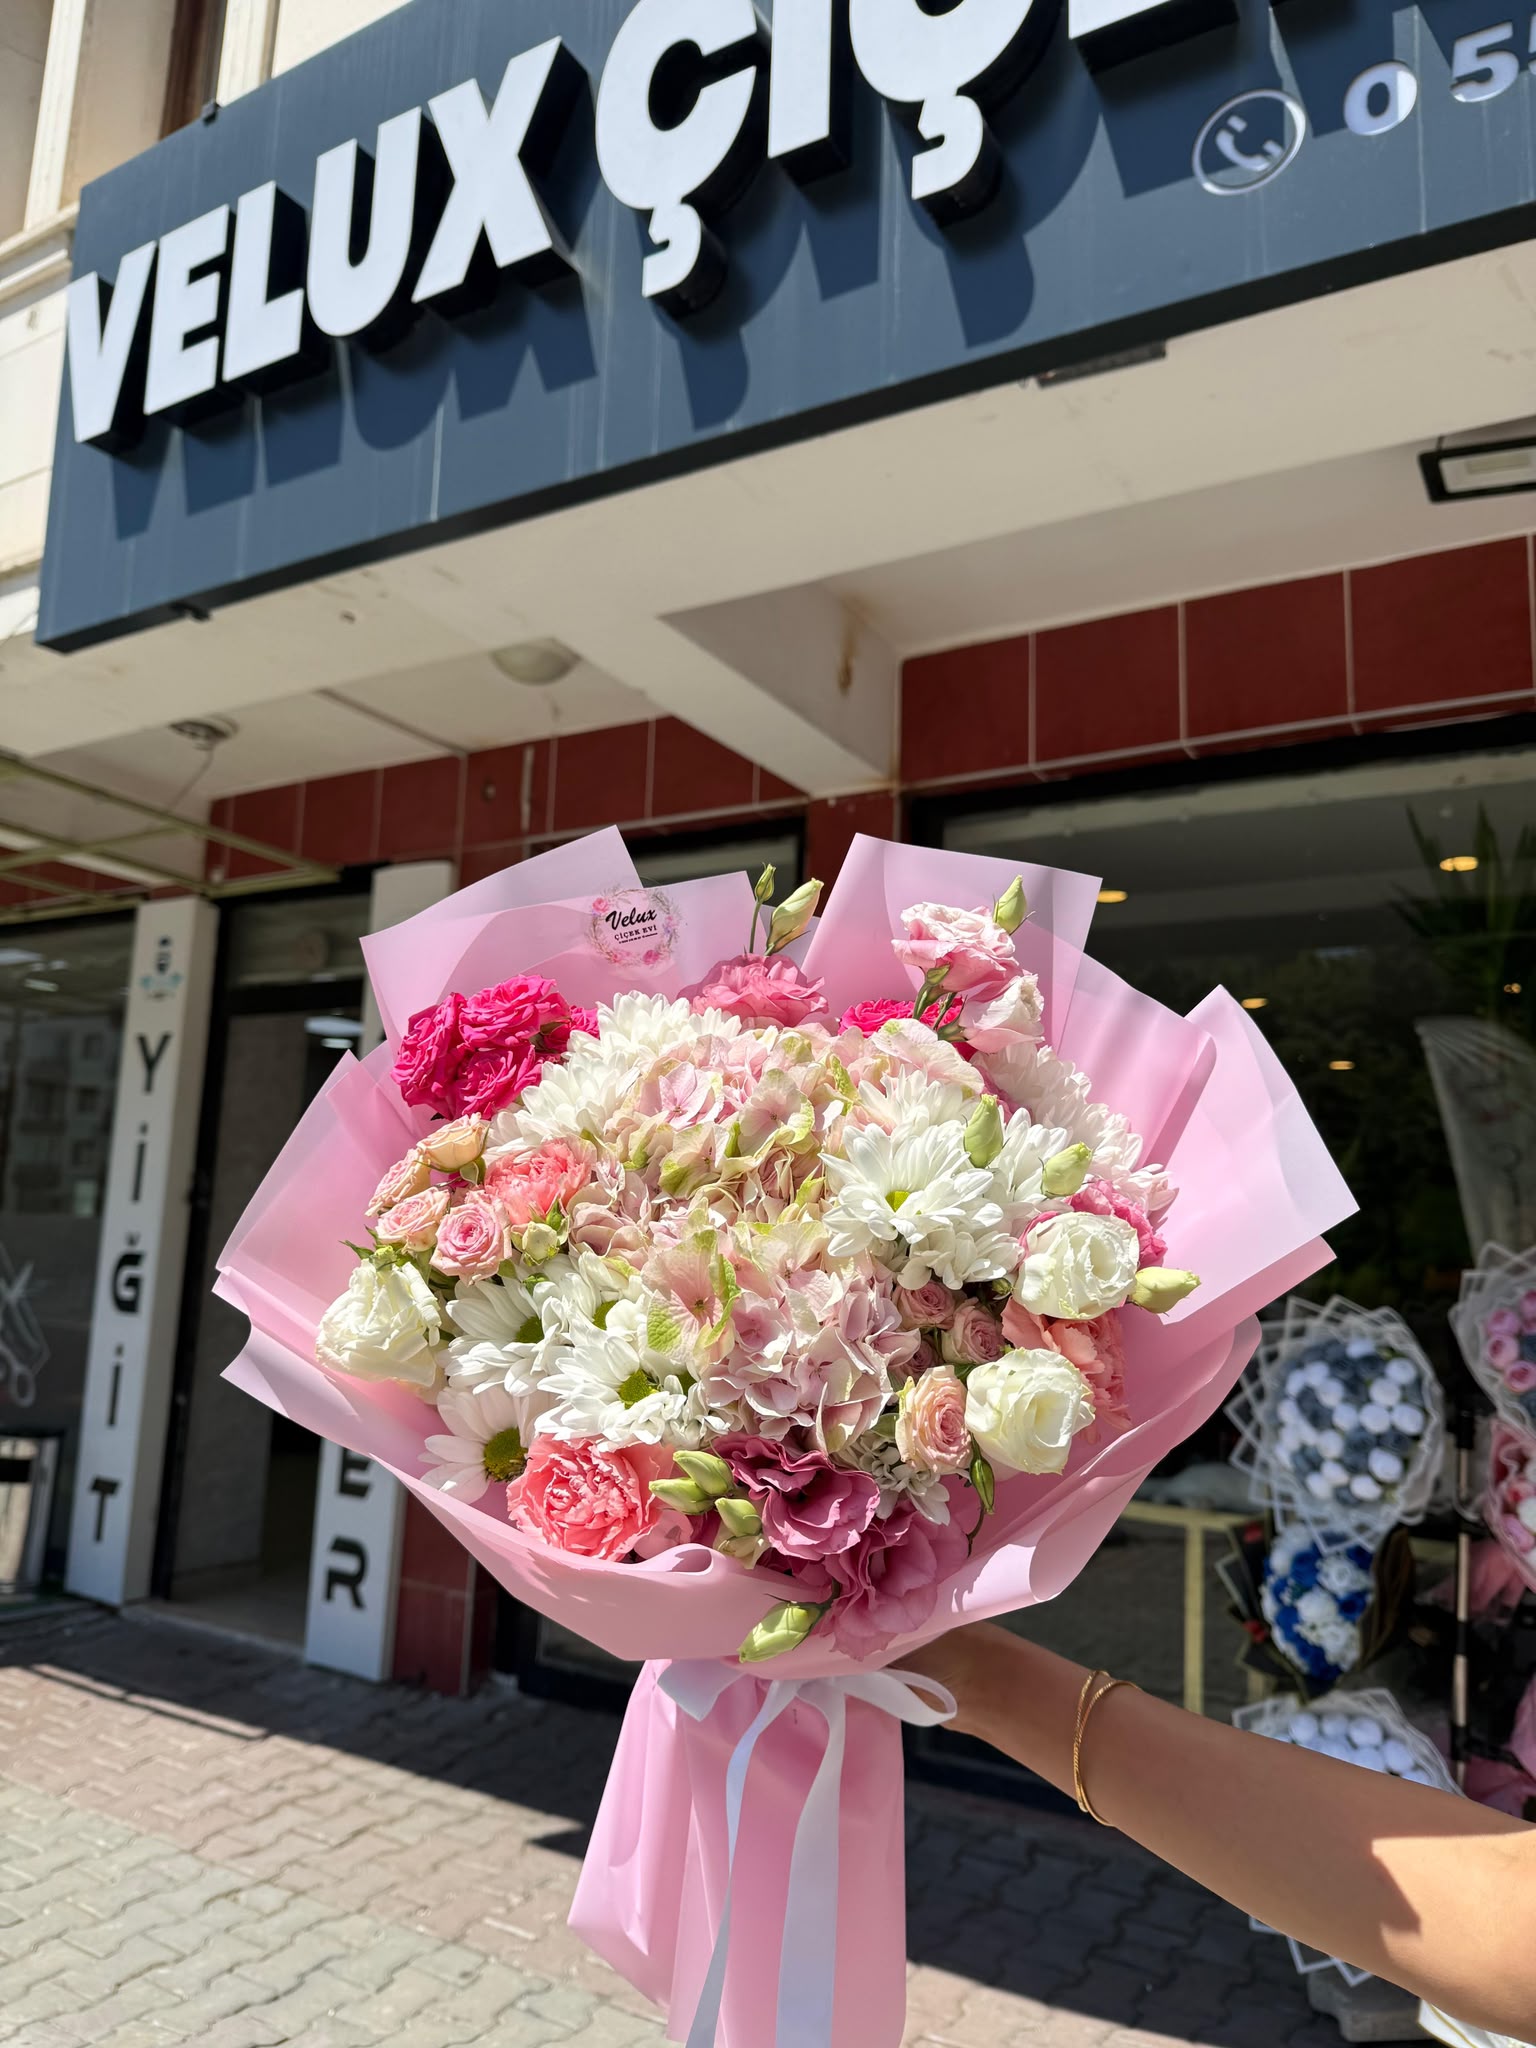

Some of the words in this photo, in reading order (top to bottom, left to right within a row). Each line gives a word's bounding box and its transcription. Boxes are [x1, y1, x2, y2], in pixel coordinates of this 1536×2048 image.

[1450, 13, 1536, 102] 5
[67, 36, 562, 443] VELUX
[605, 907, 657, 930] Velux
